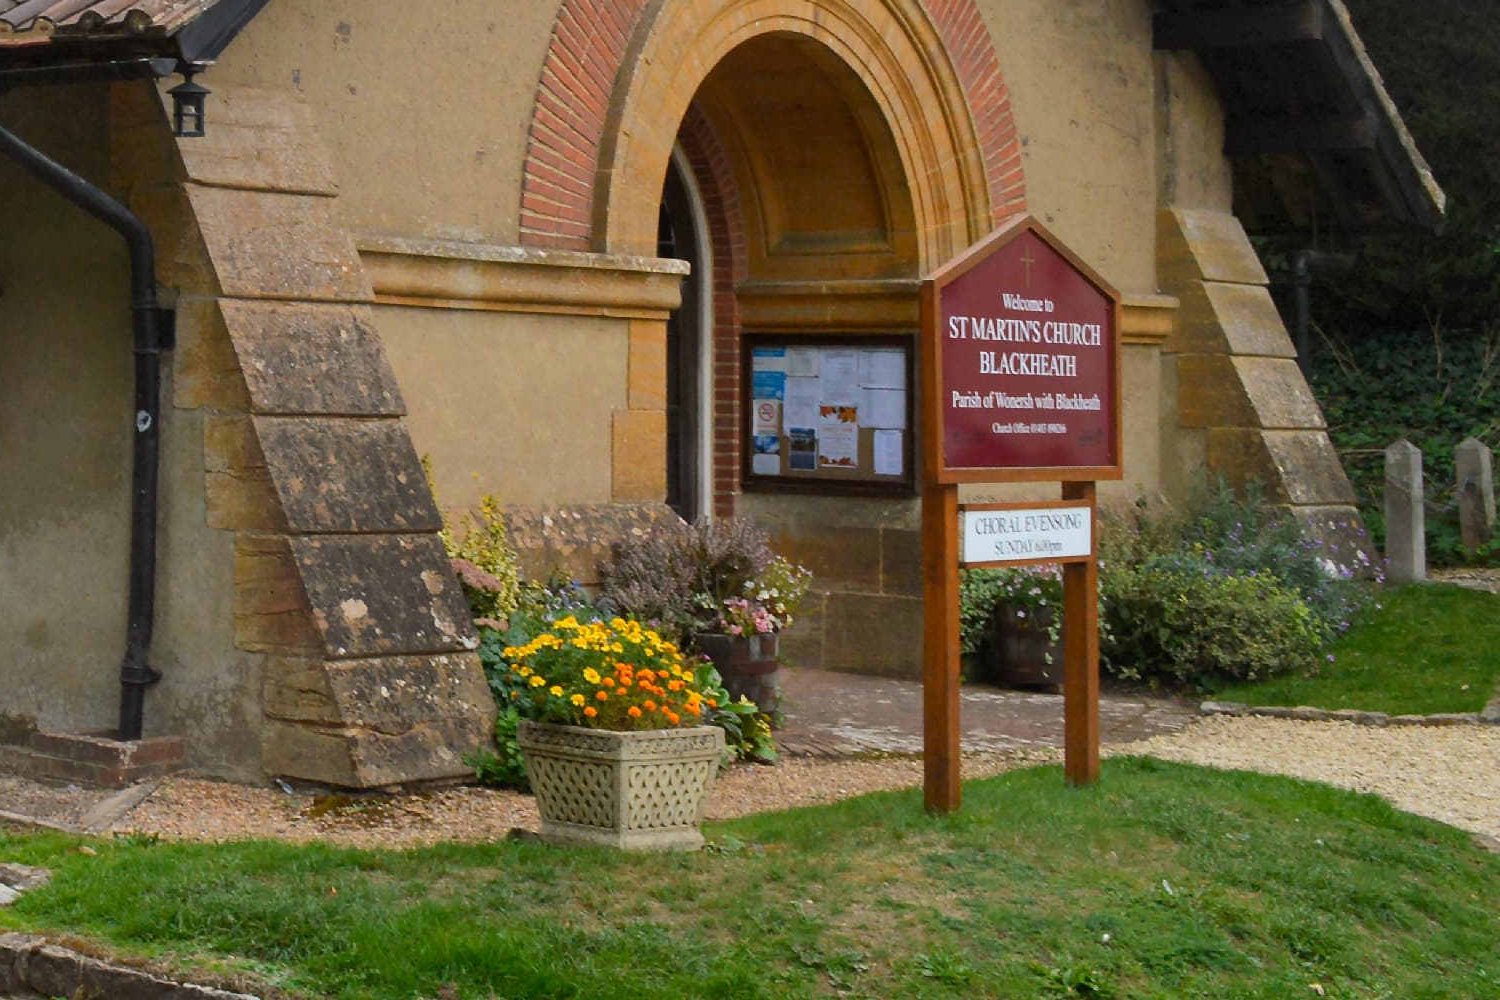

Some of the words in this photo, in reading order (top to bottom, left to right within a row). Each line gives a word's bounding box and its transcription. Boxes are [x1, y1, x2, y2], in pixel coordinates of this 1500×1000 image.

[1002, 293, 1043, 312] Welcome
[1044, 299, 1054, 312] to
[949, 316, 968, 339] ST
[972, 317, 1040, 343] MARTIN'S
[1043, 321, 1101, 345] CHURCH
[980, 351, 1077, 377] BLACKHEATH
[952, 390, 981, 408] Parish
[983, 391, 994, 408] of
[1035, 392, 1054, 409] with
[1056, 393, 1101, 410] Blackheath
[992, 422, 1012, 434] Church
[975, 516, 1020, 535] CHORAL
[1025, 513, 1082, 533] EVENSONG
[995, 540, 1033, 555] SUNDAY
